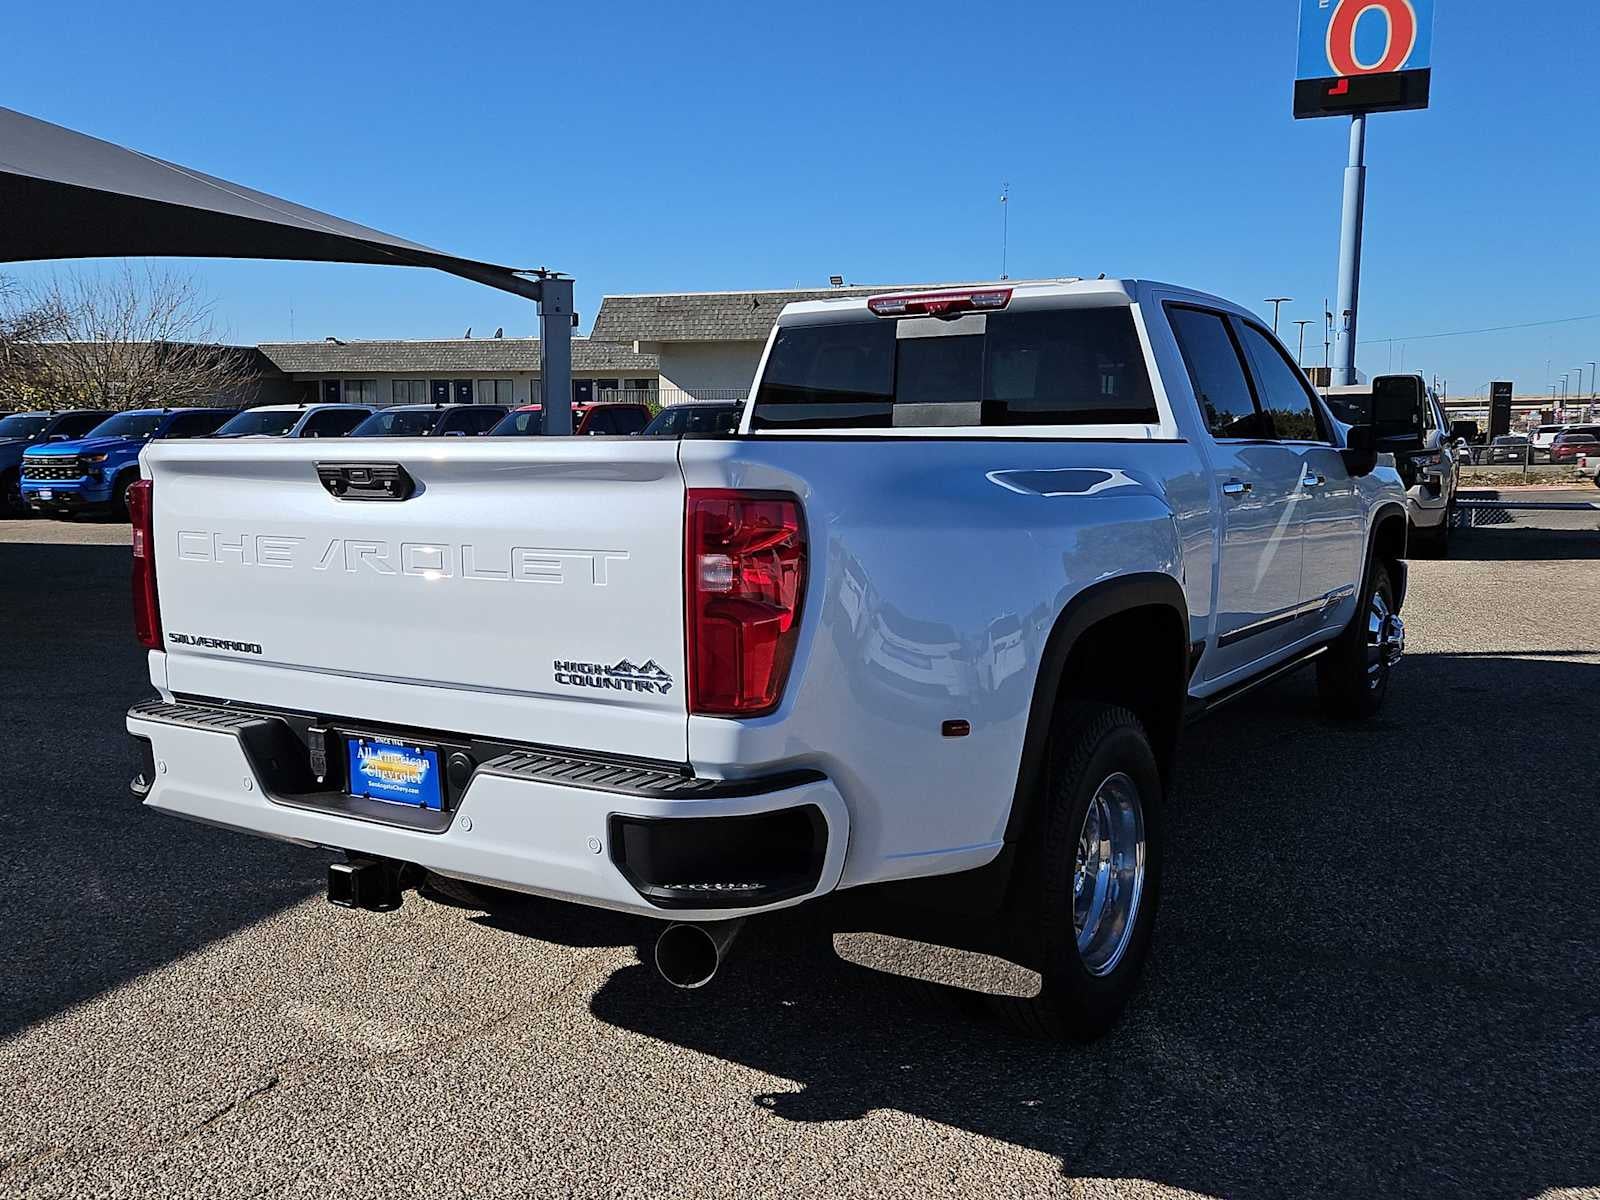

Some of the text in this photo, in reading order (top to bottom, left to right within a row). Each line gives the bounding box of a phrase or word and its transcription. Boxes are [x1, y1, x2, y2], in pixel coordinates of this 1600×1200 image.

[177, 530, 631, 586] CHEVROLET
[168, 632, 263, 655] SILVERADO
[554, 659, 613, 676] HIGH
[554, 672, 673, 695] COUNTRY
[357, 747, 430, 768] All American
[366, 764, 422, 784] Chevrolet
